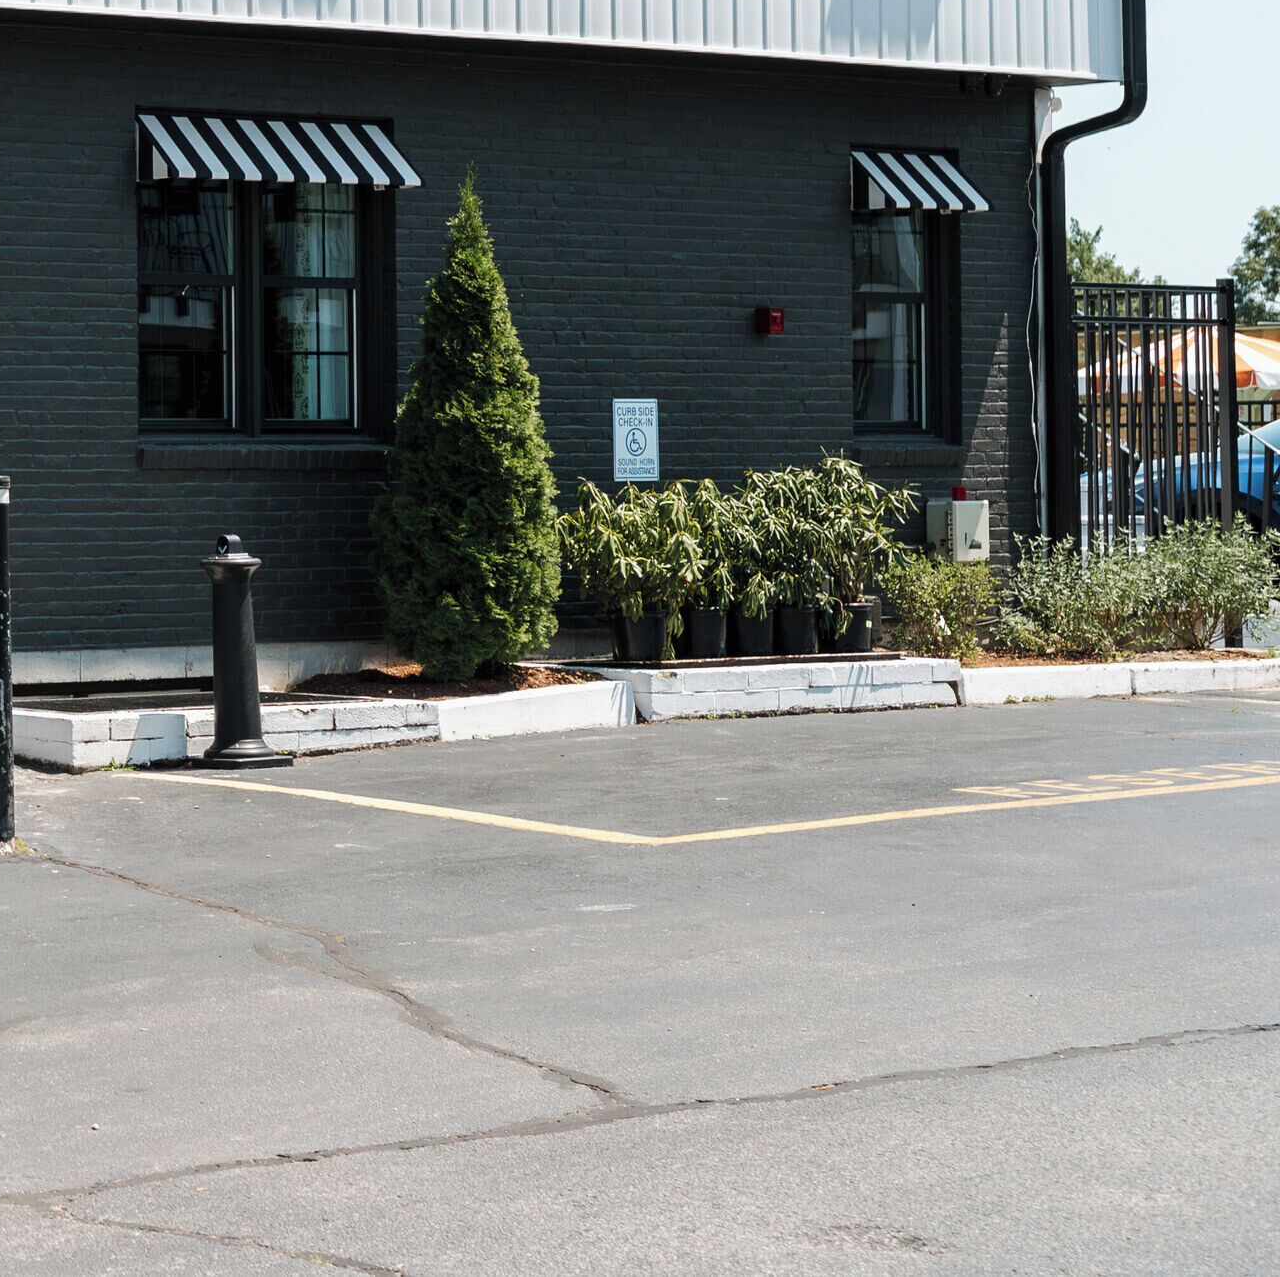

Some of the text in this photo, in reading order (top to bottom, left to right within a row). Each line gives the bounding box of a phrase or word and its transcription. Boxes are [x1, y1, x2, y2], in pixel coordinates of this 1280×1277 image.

[617, 407, 654, 416] CURB SIDE
[618, 417, 653, 427] CHECK-IN
[618, 458, 655, 466] SOUND HORN
[618, 467, 656, 475] FOR ASSISTANCE
